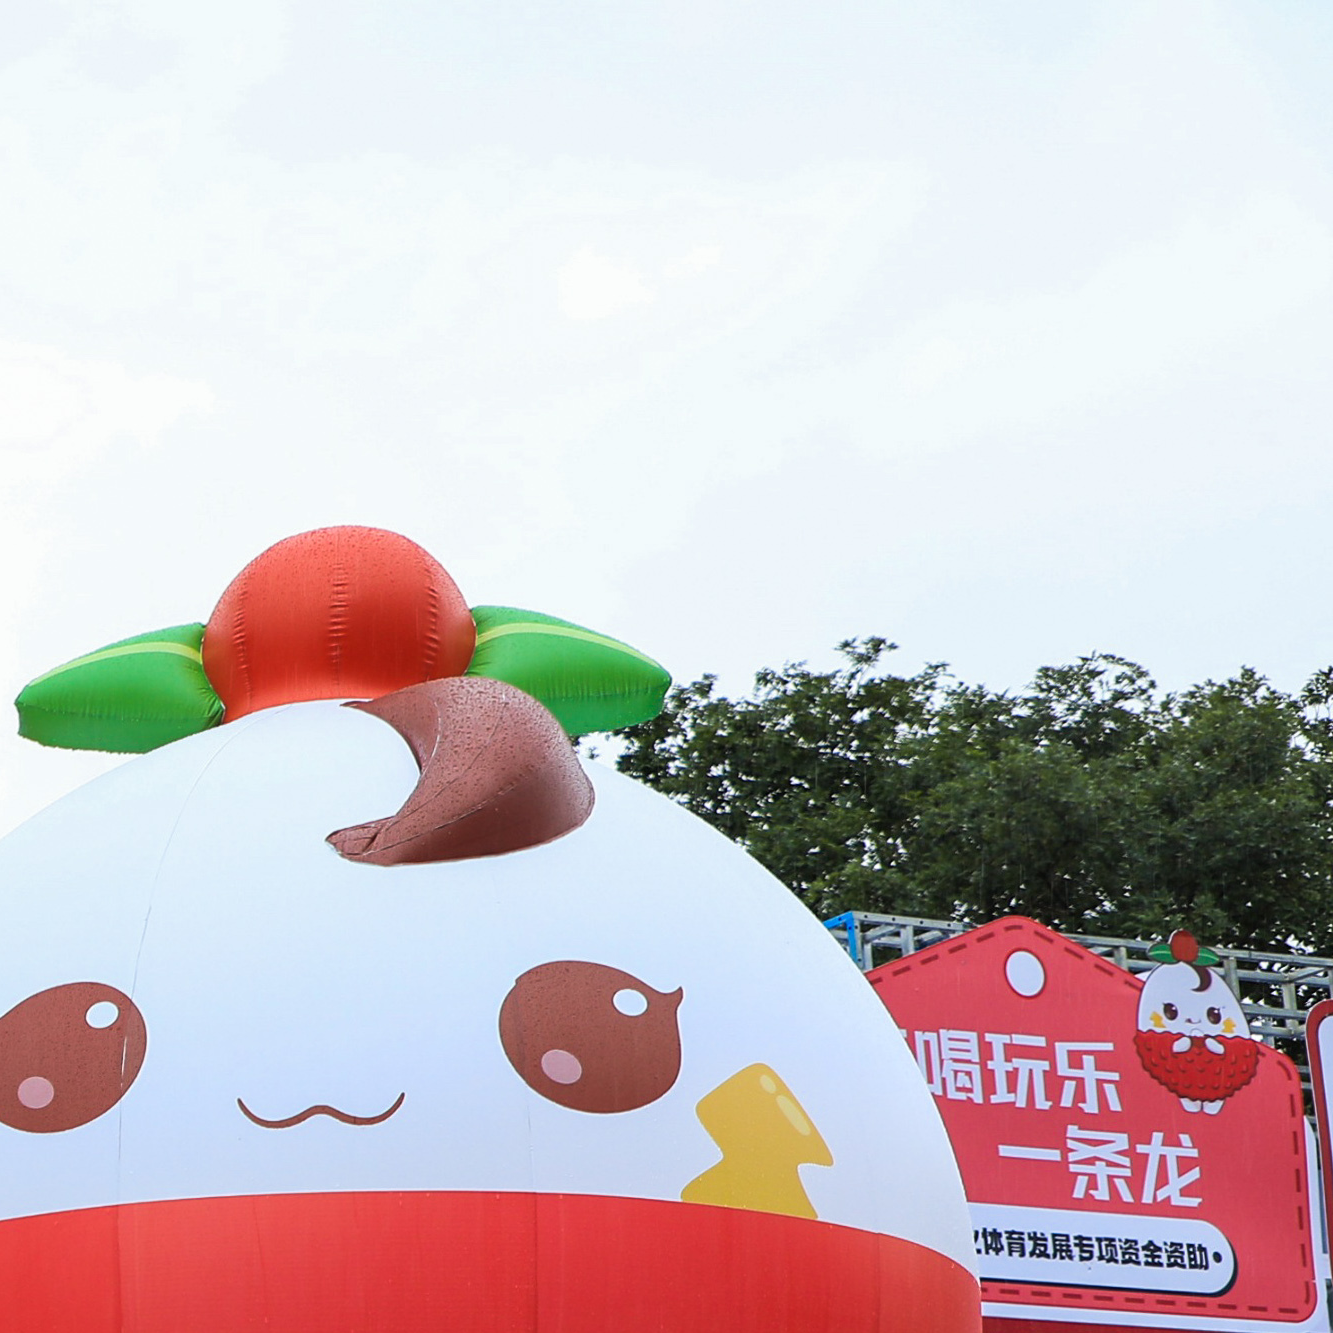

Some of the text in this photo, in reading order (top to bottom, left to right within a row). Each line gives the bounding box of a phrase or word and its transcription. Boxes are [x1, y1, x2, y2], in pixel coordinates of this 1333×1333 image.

[900, 1029, 1123, 1114] 喝玩乐
[998, 1124, 1202, 1207] 一条龙
